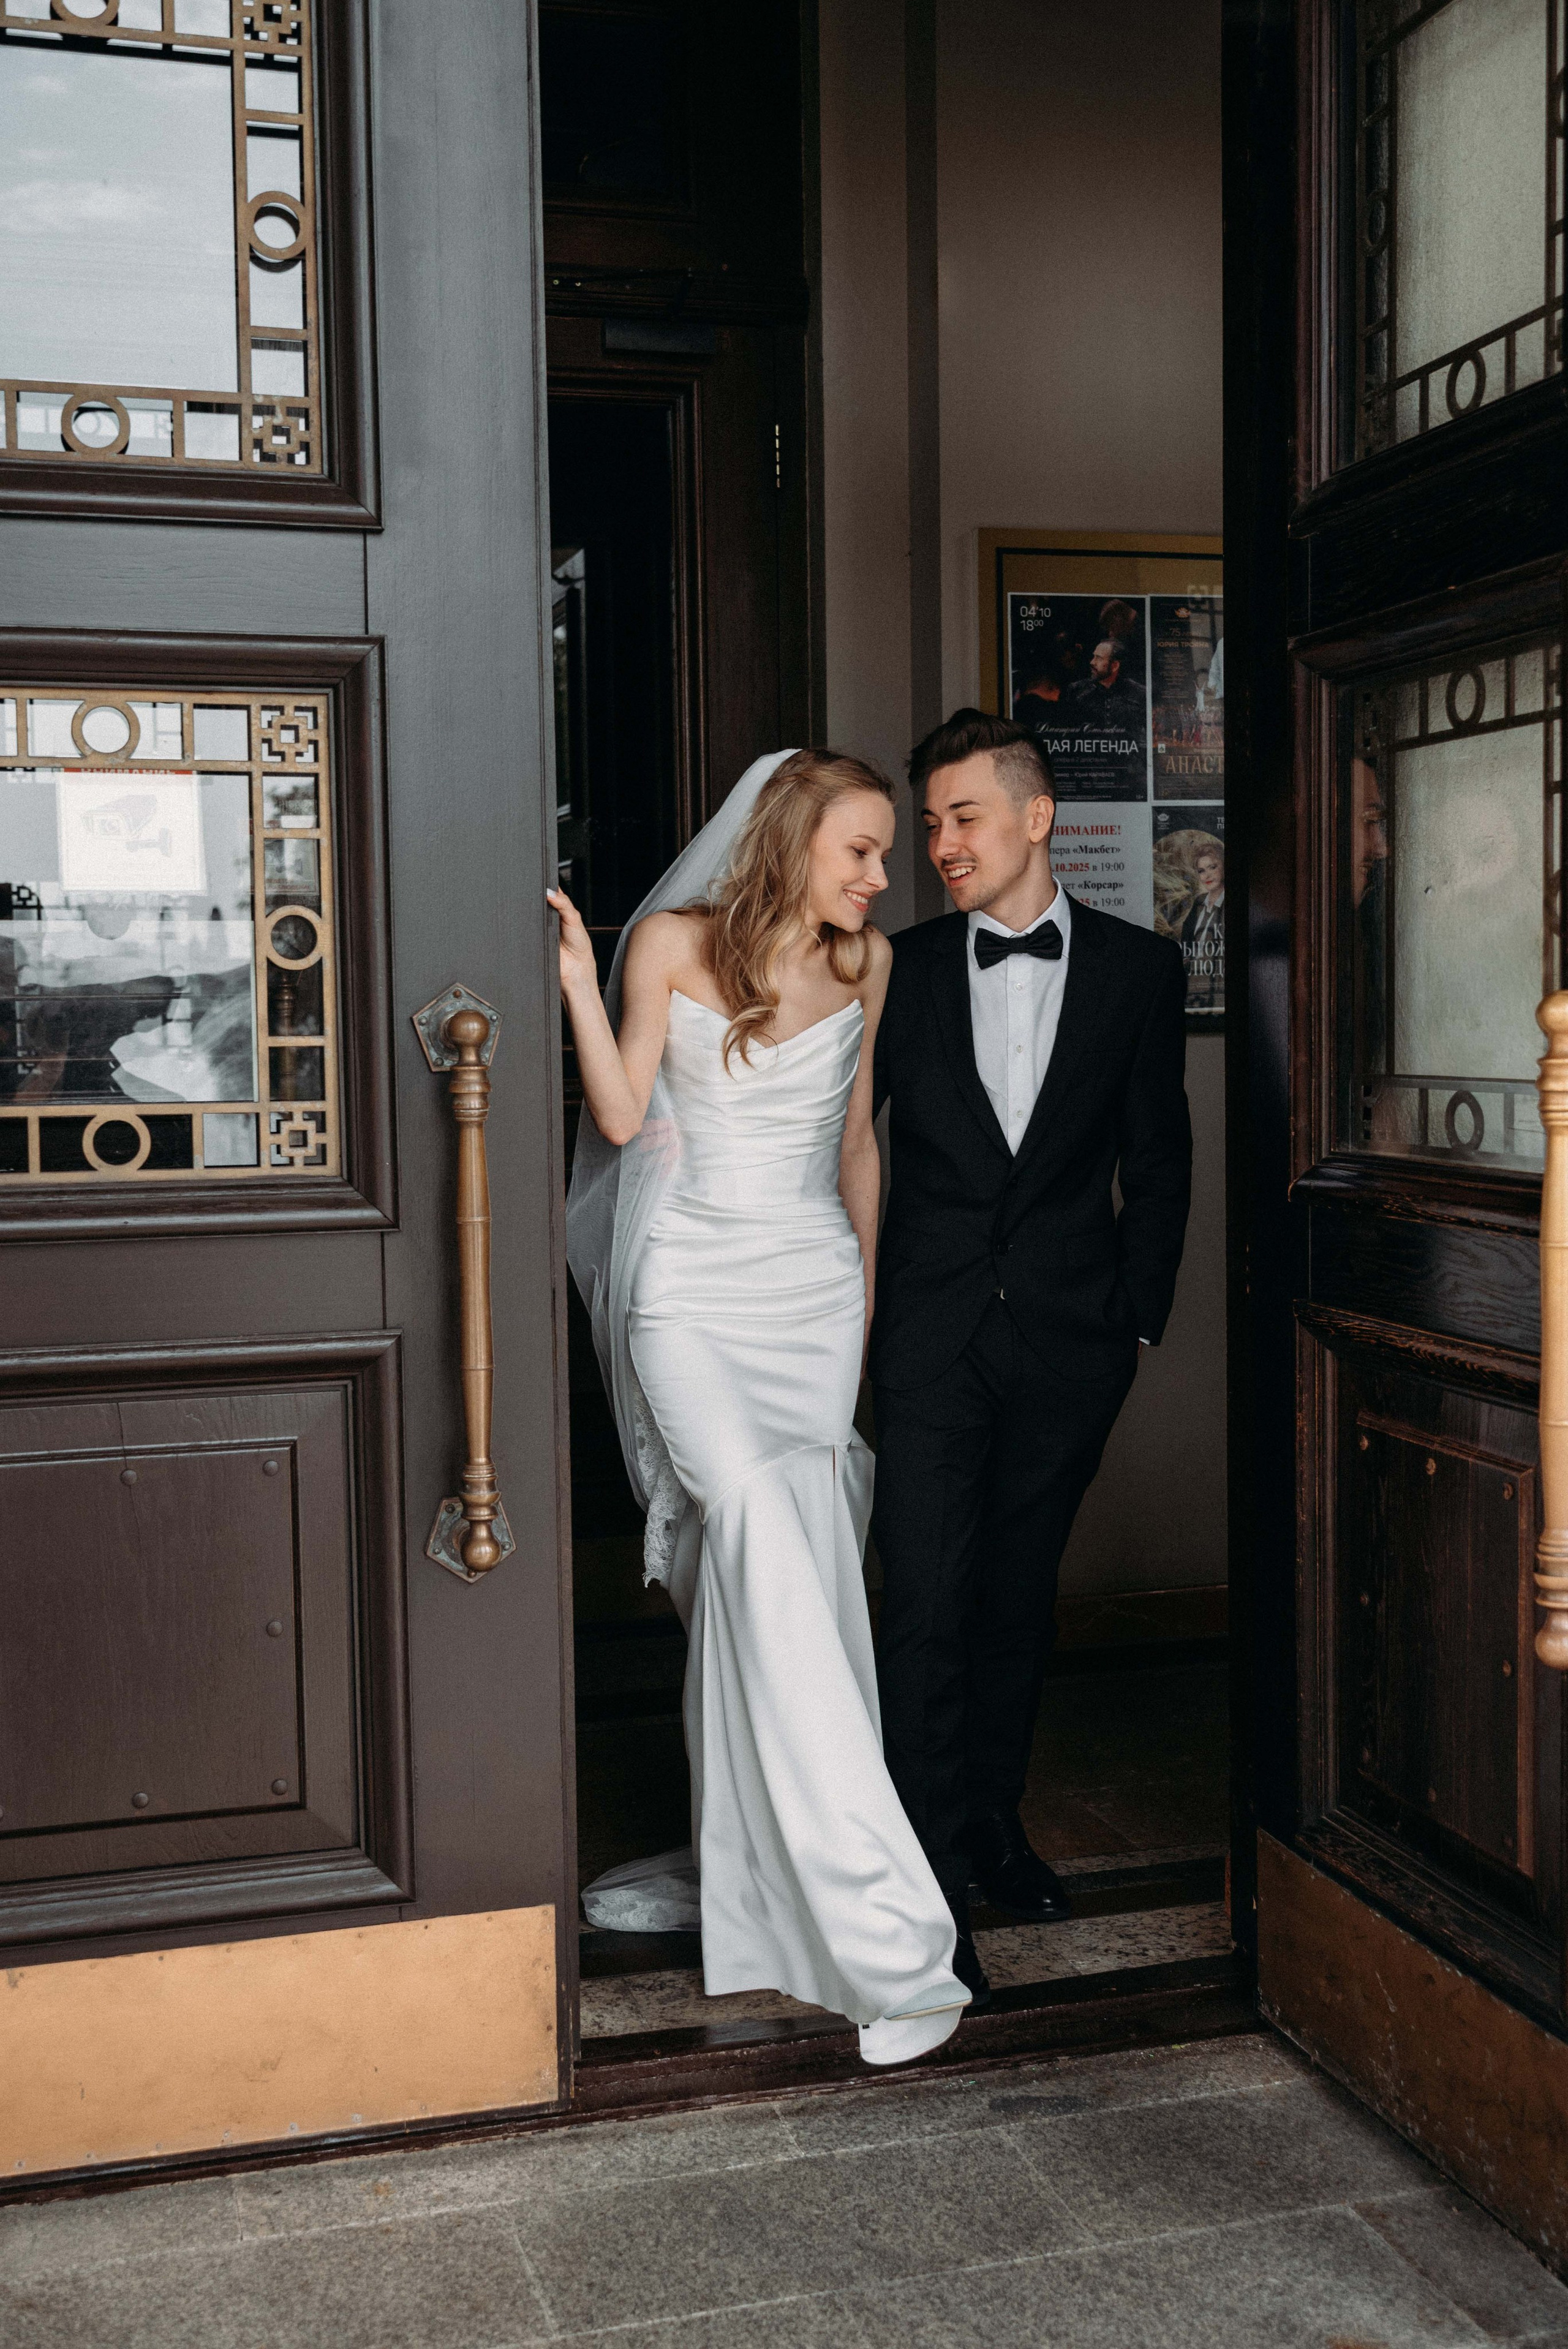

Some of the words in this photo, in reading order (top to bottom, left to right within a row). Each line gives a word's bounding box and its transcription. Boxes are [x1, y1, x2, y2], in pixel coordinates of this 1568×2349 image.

[1074, 739, 1139, 755] ЛЕГЕНДА
[1166, 755, 1224, 774] АНАСТ
[1052, 825, 1121, 835] НИМАНИЕ!
[1049, 848, 1070, 856] пера
[1072, 845, 1121, 854] «Макбет»
[1052, 862, 1090, 872] .10.2025
[1101, 862, 1125, 872] 19:00
[1078, 880, 1123, 891] «Корсар»
[1101, 897, 1125, 907] 19:00
[1188, 959, 1224, 978] ЛЮД
